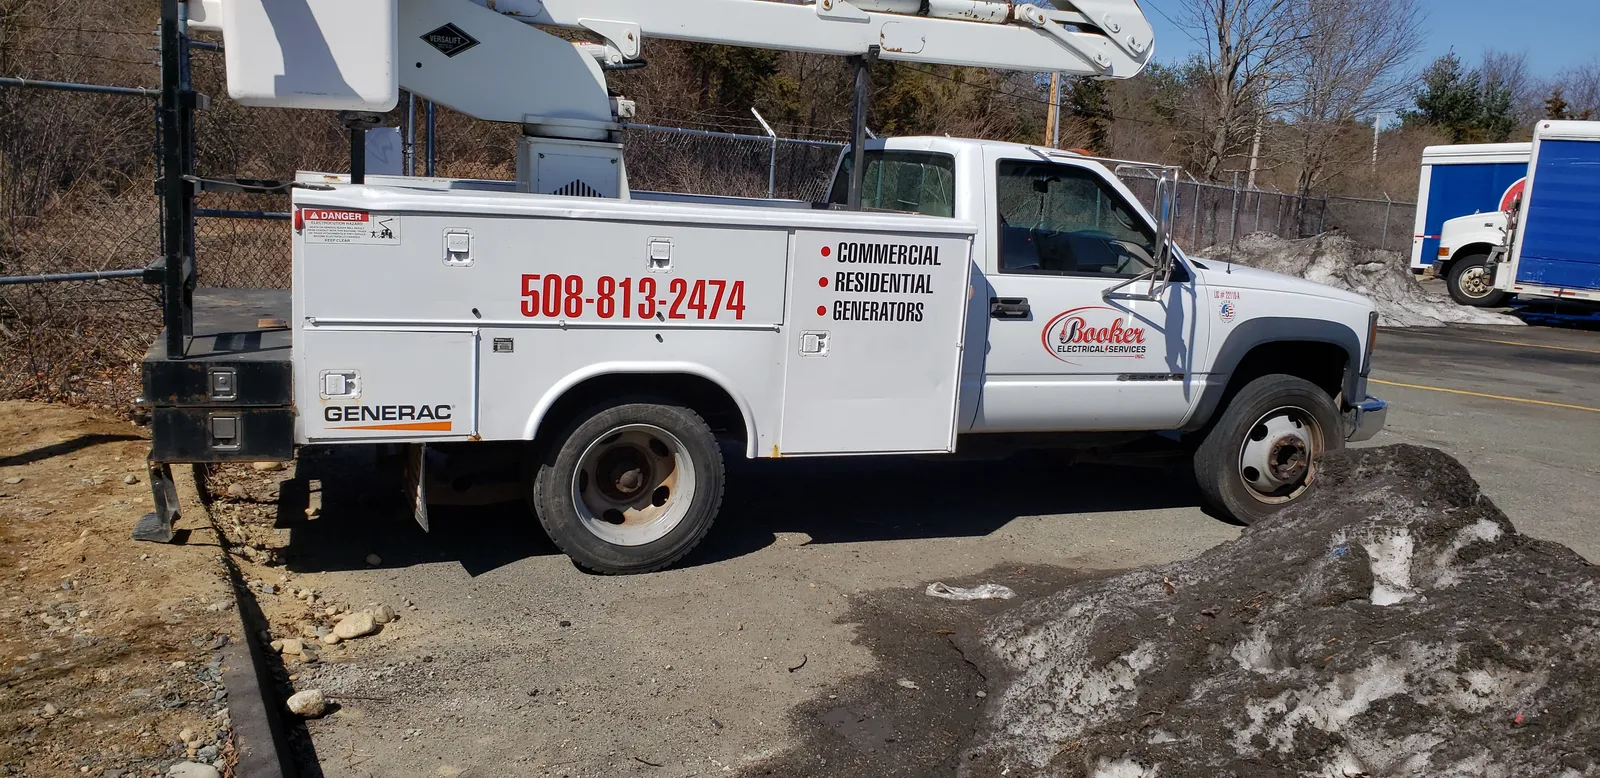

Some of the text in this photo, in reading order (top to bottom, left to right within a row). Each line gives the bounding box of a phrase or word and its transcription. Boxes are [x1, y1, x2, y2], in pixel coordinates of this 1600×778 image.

[430, 35, 461, 44] VERSALIFT
[321, 212, 362, 220] DANGER
[837, 242, 941, 266] COMMERCIAL
[834, 271, 934, 294] RESIDENTIAL
[520, 273, 746, 320] 508-813-2474
[832, 300, 924, 322] GENERATORS
[1059, 316, 1146, 344] Booker
[1057, 345, 1146, 353] ELECTRICAL SERVICES
[324, 404, 452, 422] GENERAC
